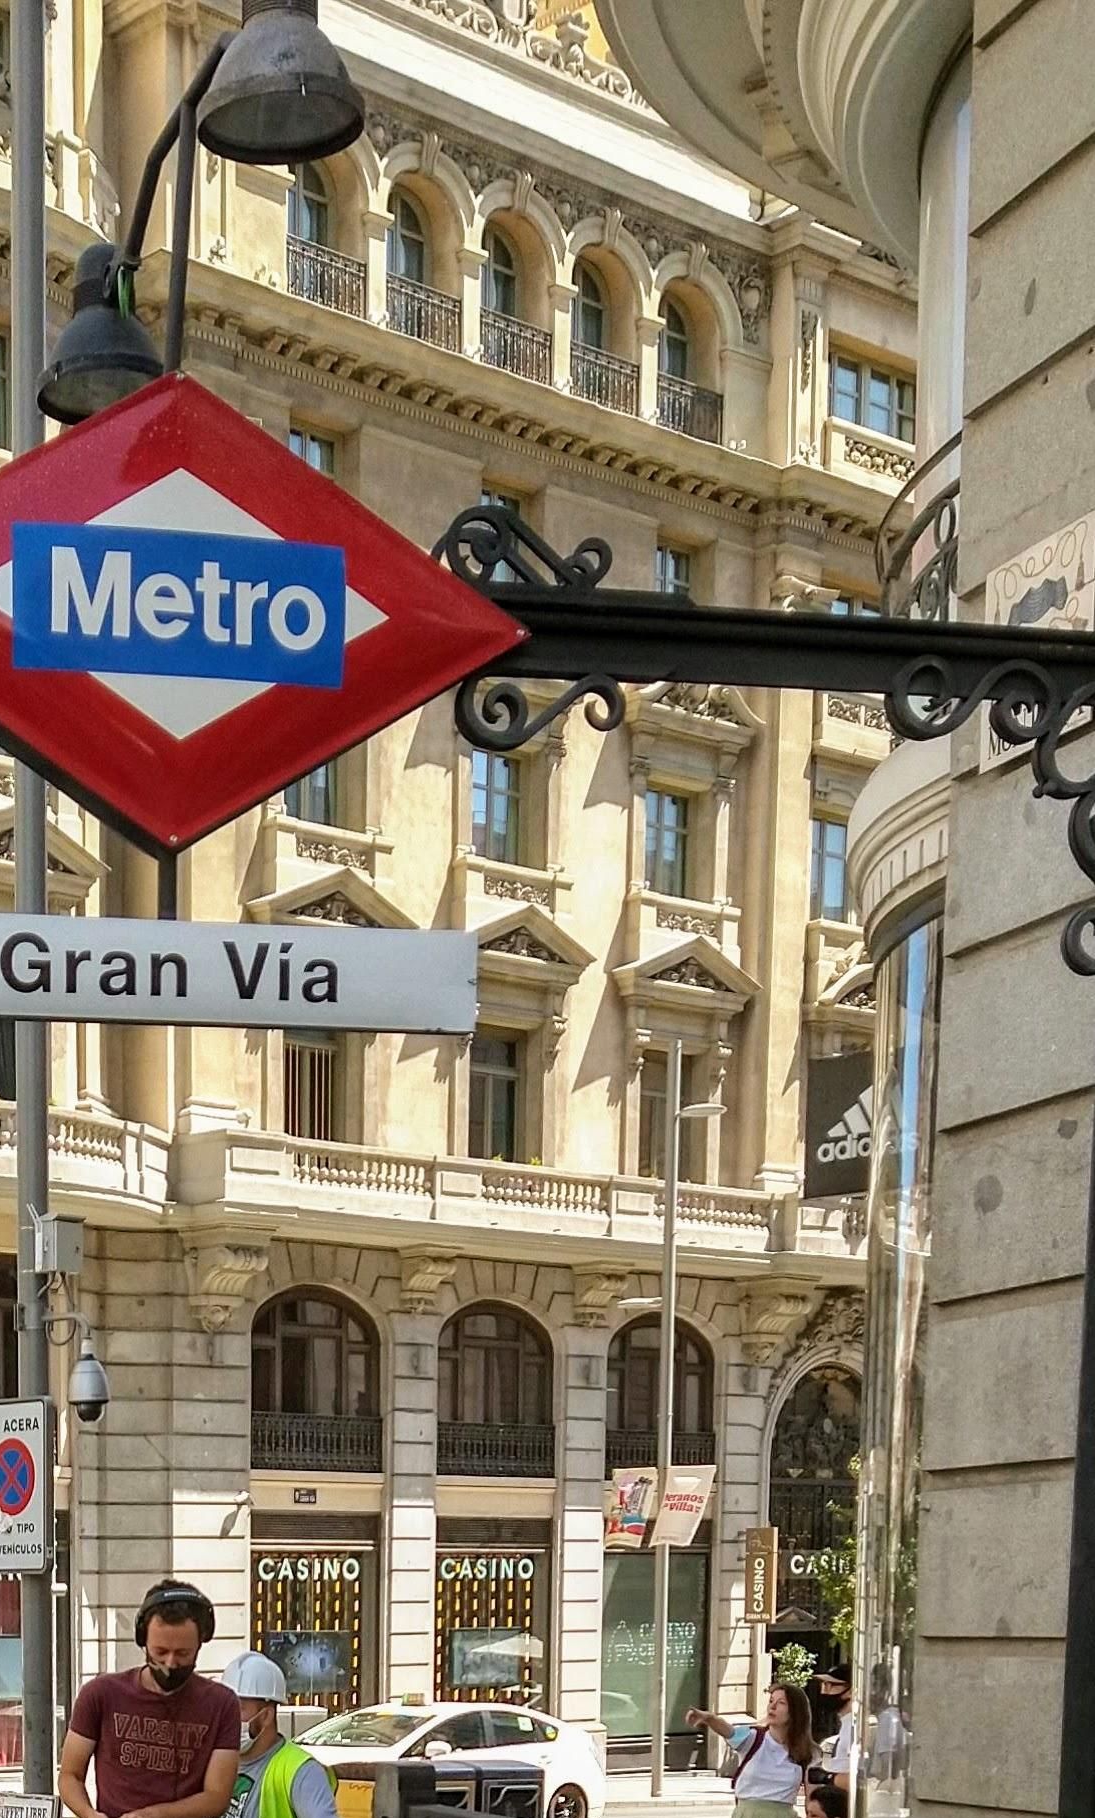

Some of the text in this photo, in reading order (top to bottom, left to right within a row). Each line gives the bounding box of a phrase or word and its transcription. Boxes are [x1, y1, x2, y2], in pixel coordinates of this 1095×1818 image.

[49, 546, 327, 652] Metro
[0, 931, 341, 1004] Gran Vía
[3, 1417, 41, 1433] ACERA
[16, 1522, 36, 1534] TIPO
[258, 1557, 361, 1581] CASINO
[440, 1558, 535, 1580] CASINO
[753, 1557, 766, 1613] CASINO
[113, 1711, 209, 1749] VARSITY
[119, 1741, 195, 1775] SPIRIT
